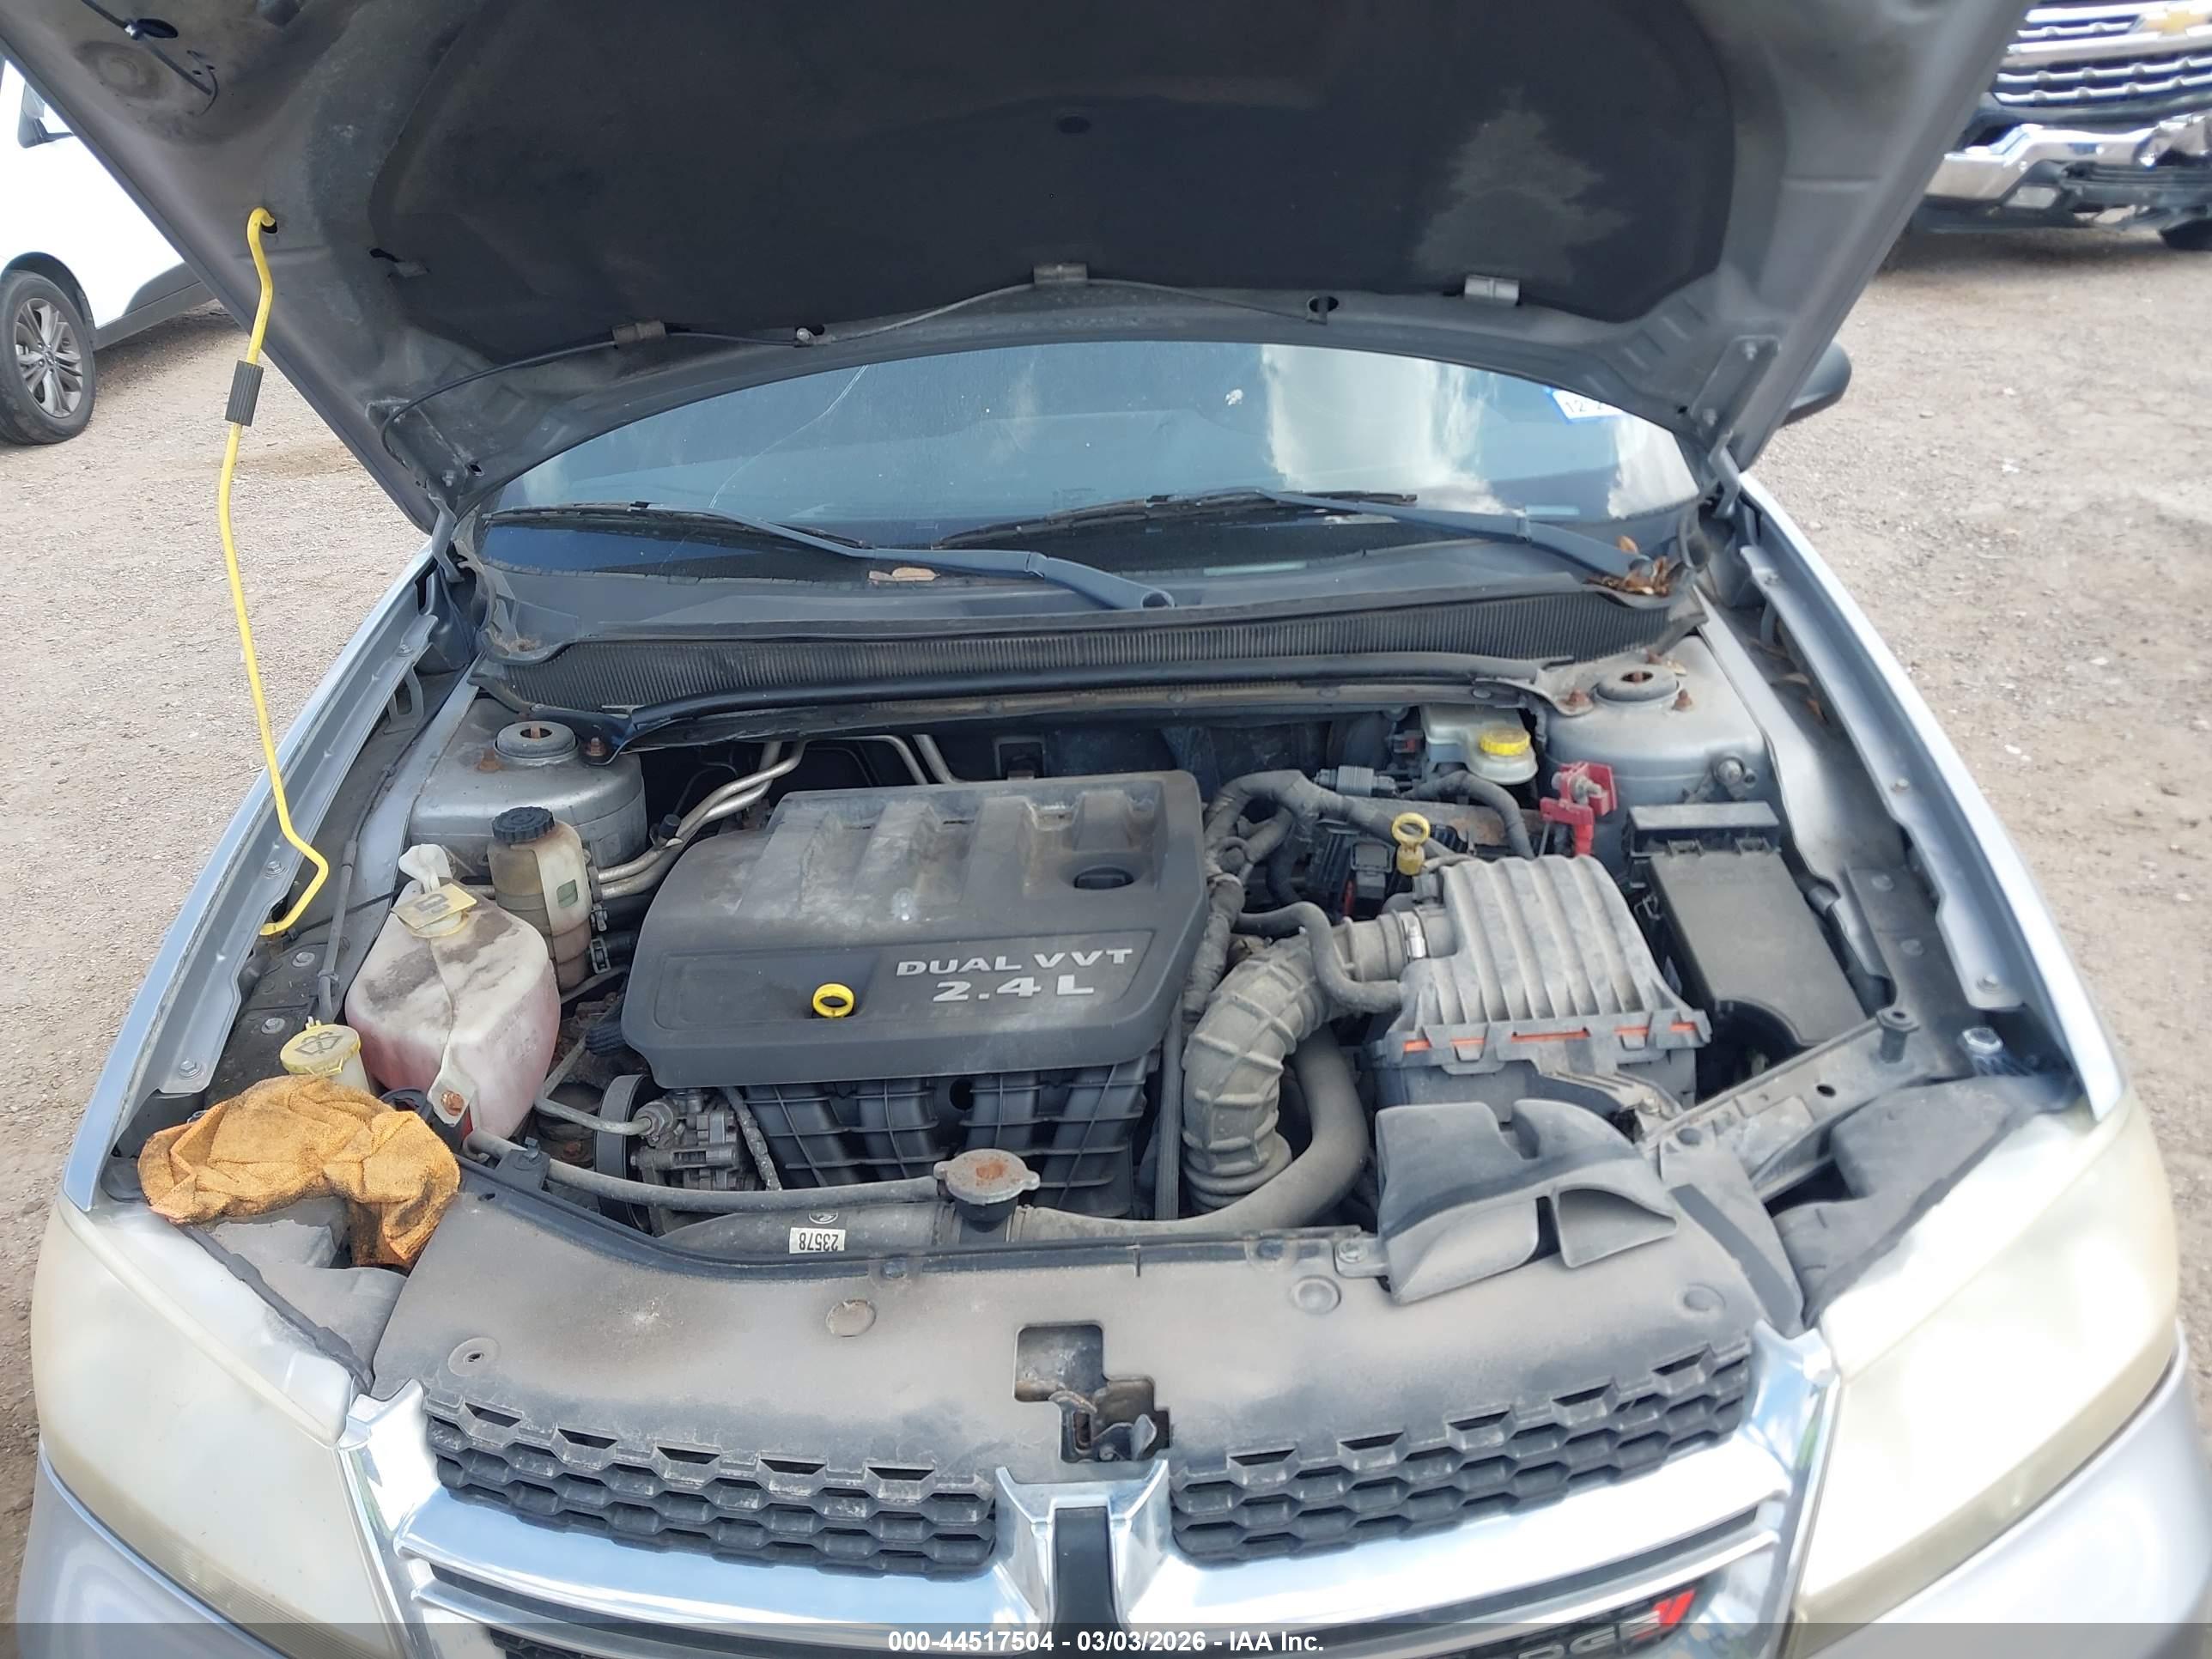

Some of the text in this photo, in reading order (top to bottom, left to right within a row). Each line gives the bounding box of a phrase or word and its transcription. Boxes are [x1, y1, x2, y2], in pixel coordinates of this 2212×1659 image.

[896, 948, 1133, 976] DUAL VVT
[799, 1232, 839, 1251] 23578
